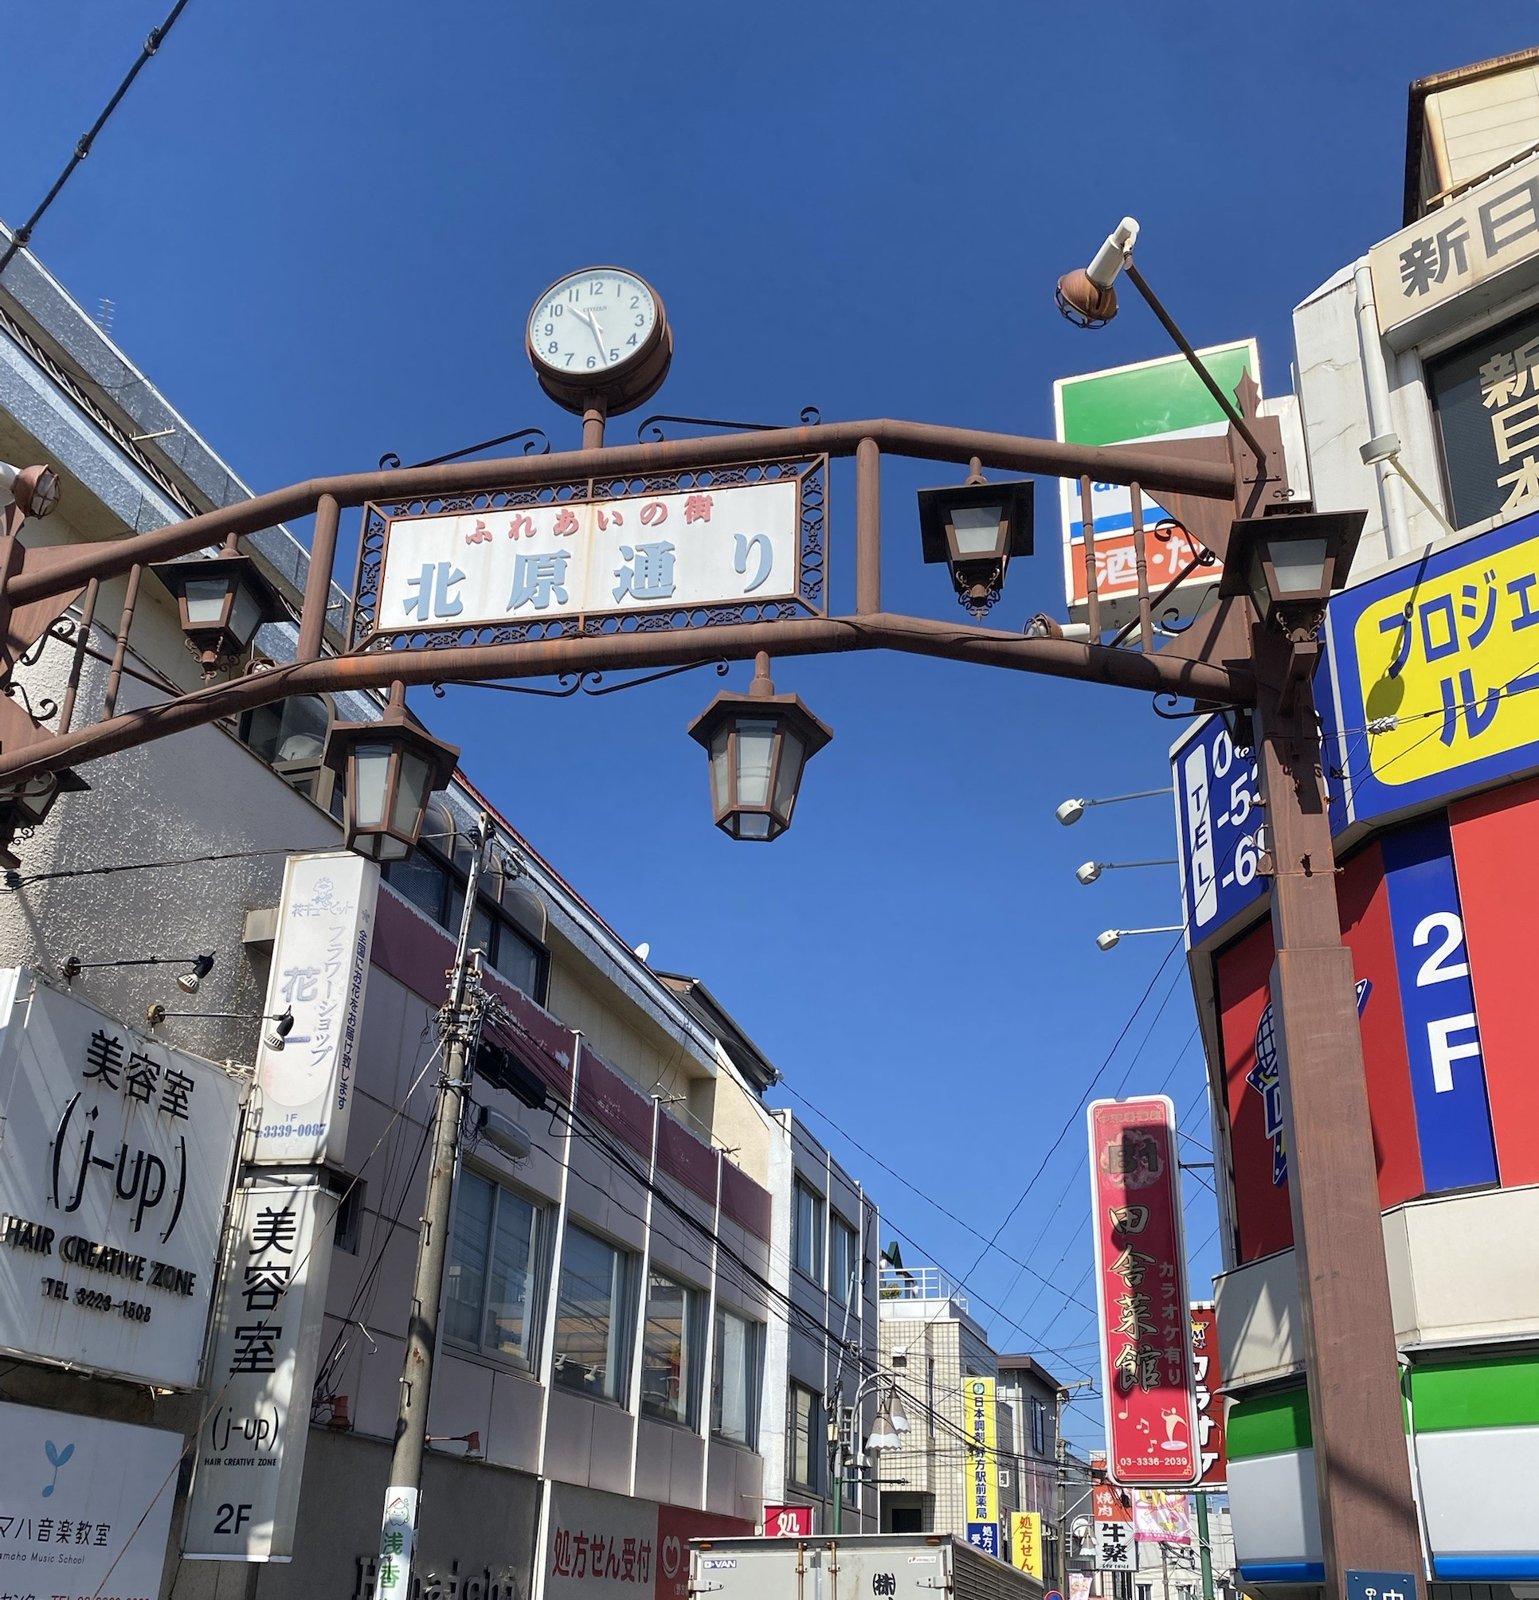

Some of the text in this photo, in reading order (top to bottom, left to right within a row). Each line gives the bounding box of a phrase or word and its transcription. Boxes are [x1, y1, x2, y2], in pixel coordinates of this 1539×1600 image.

[590, 282, 603, 295] 12
[617, 284, 621, 297] 1
[569, 289, 579, 302] 11
[630, 296, 639, 309] 2
[550, 304, 563, 317] 10
[634, 314, 644, 326] 3
[544, 323, 553, 336] 9
[626, 333, 638, 346] 4
[548, 341, 558, 354] 8
[564, 353, 574, 366] 7
[609, 348, 620, 361] 5
[586, 356, 595, 368] 6
[465, 494, 714, 546] ふれあいの街
[402, 532, 774, 622] 北原通り
[1191, 783, 1210, 888] TEL
[1412, 911, 1481, 1094] 2F
[82, 1029, 195, 1121] 美容室
[285, 1113, 298, 1122] 1F
[1109, 1142, 1158, 1174] B1
[3, 1214, 196, 1297] HAIR CREATIVE ZONE
[42, 1277, 69, 1301] TEL
[229, 1205, 297, 1374] 美容室
[1158, 1261, 1182, 1386] カラオケ有り
[204, 1457, 277, 1467] HAIR CREATIVE ZONE
[1120, 1457, 1188, 1467] 03-3336-2039
[1096, 1492, 1114, 1517] 焼肉
[213, 1503, 252, 1535] 2F
[1102, 1523, 1128, 1562] 牛繁
[31, 1552, 54, 1563] Music
[58, 1554, 85, 1564] School
[552, 1527, 651, 1583] 処方せん受付
